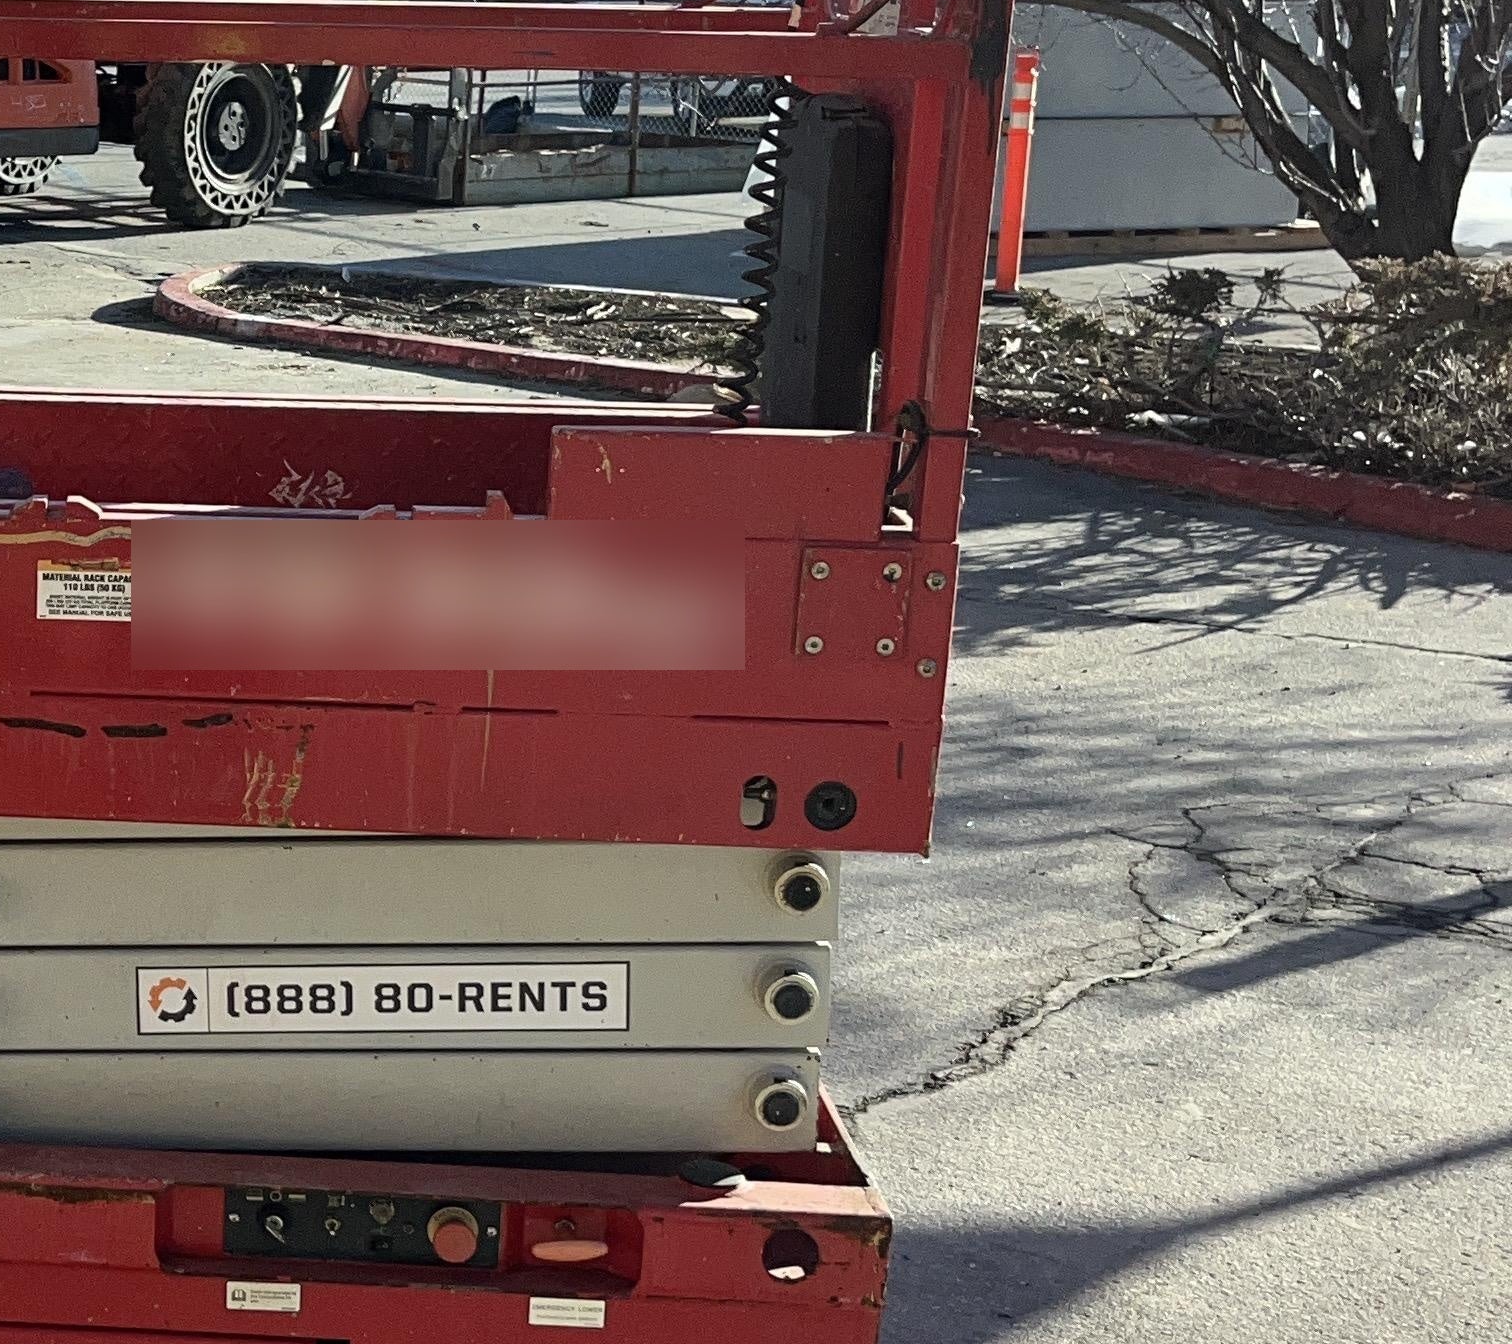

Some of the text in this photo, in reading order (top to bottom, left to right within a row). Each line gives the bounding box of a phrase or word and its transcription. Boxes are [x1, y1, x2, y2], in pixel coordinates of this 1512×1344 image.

[42, 573, 82, 582] MATERIAL
[83, 574, 105, 582] RACK
[63, 583, 78, 591] 110
[80, 583, 95, 591] LBS
[226, 979, 609, 1018] (888) 80-RENTS
